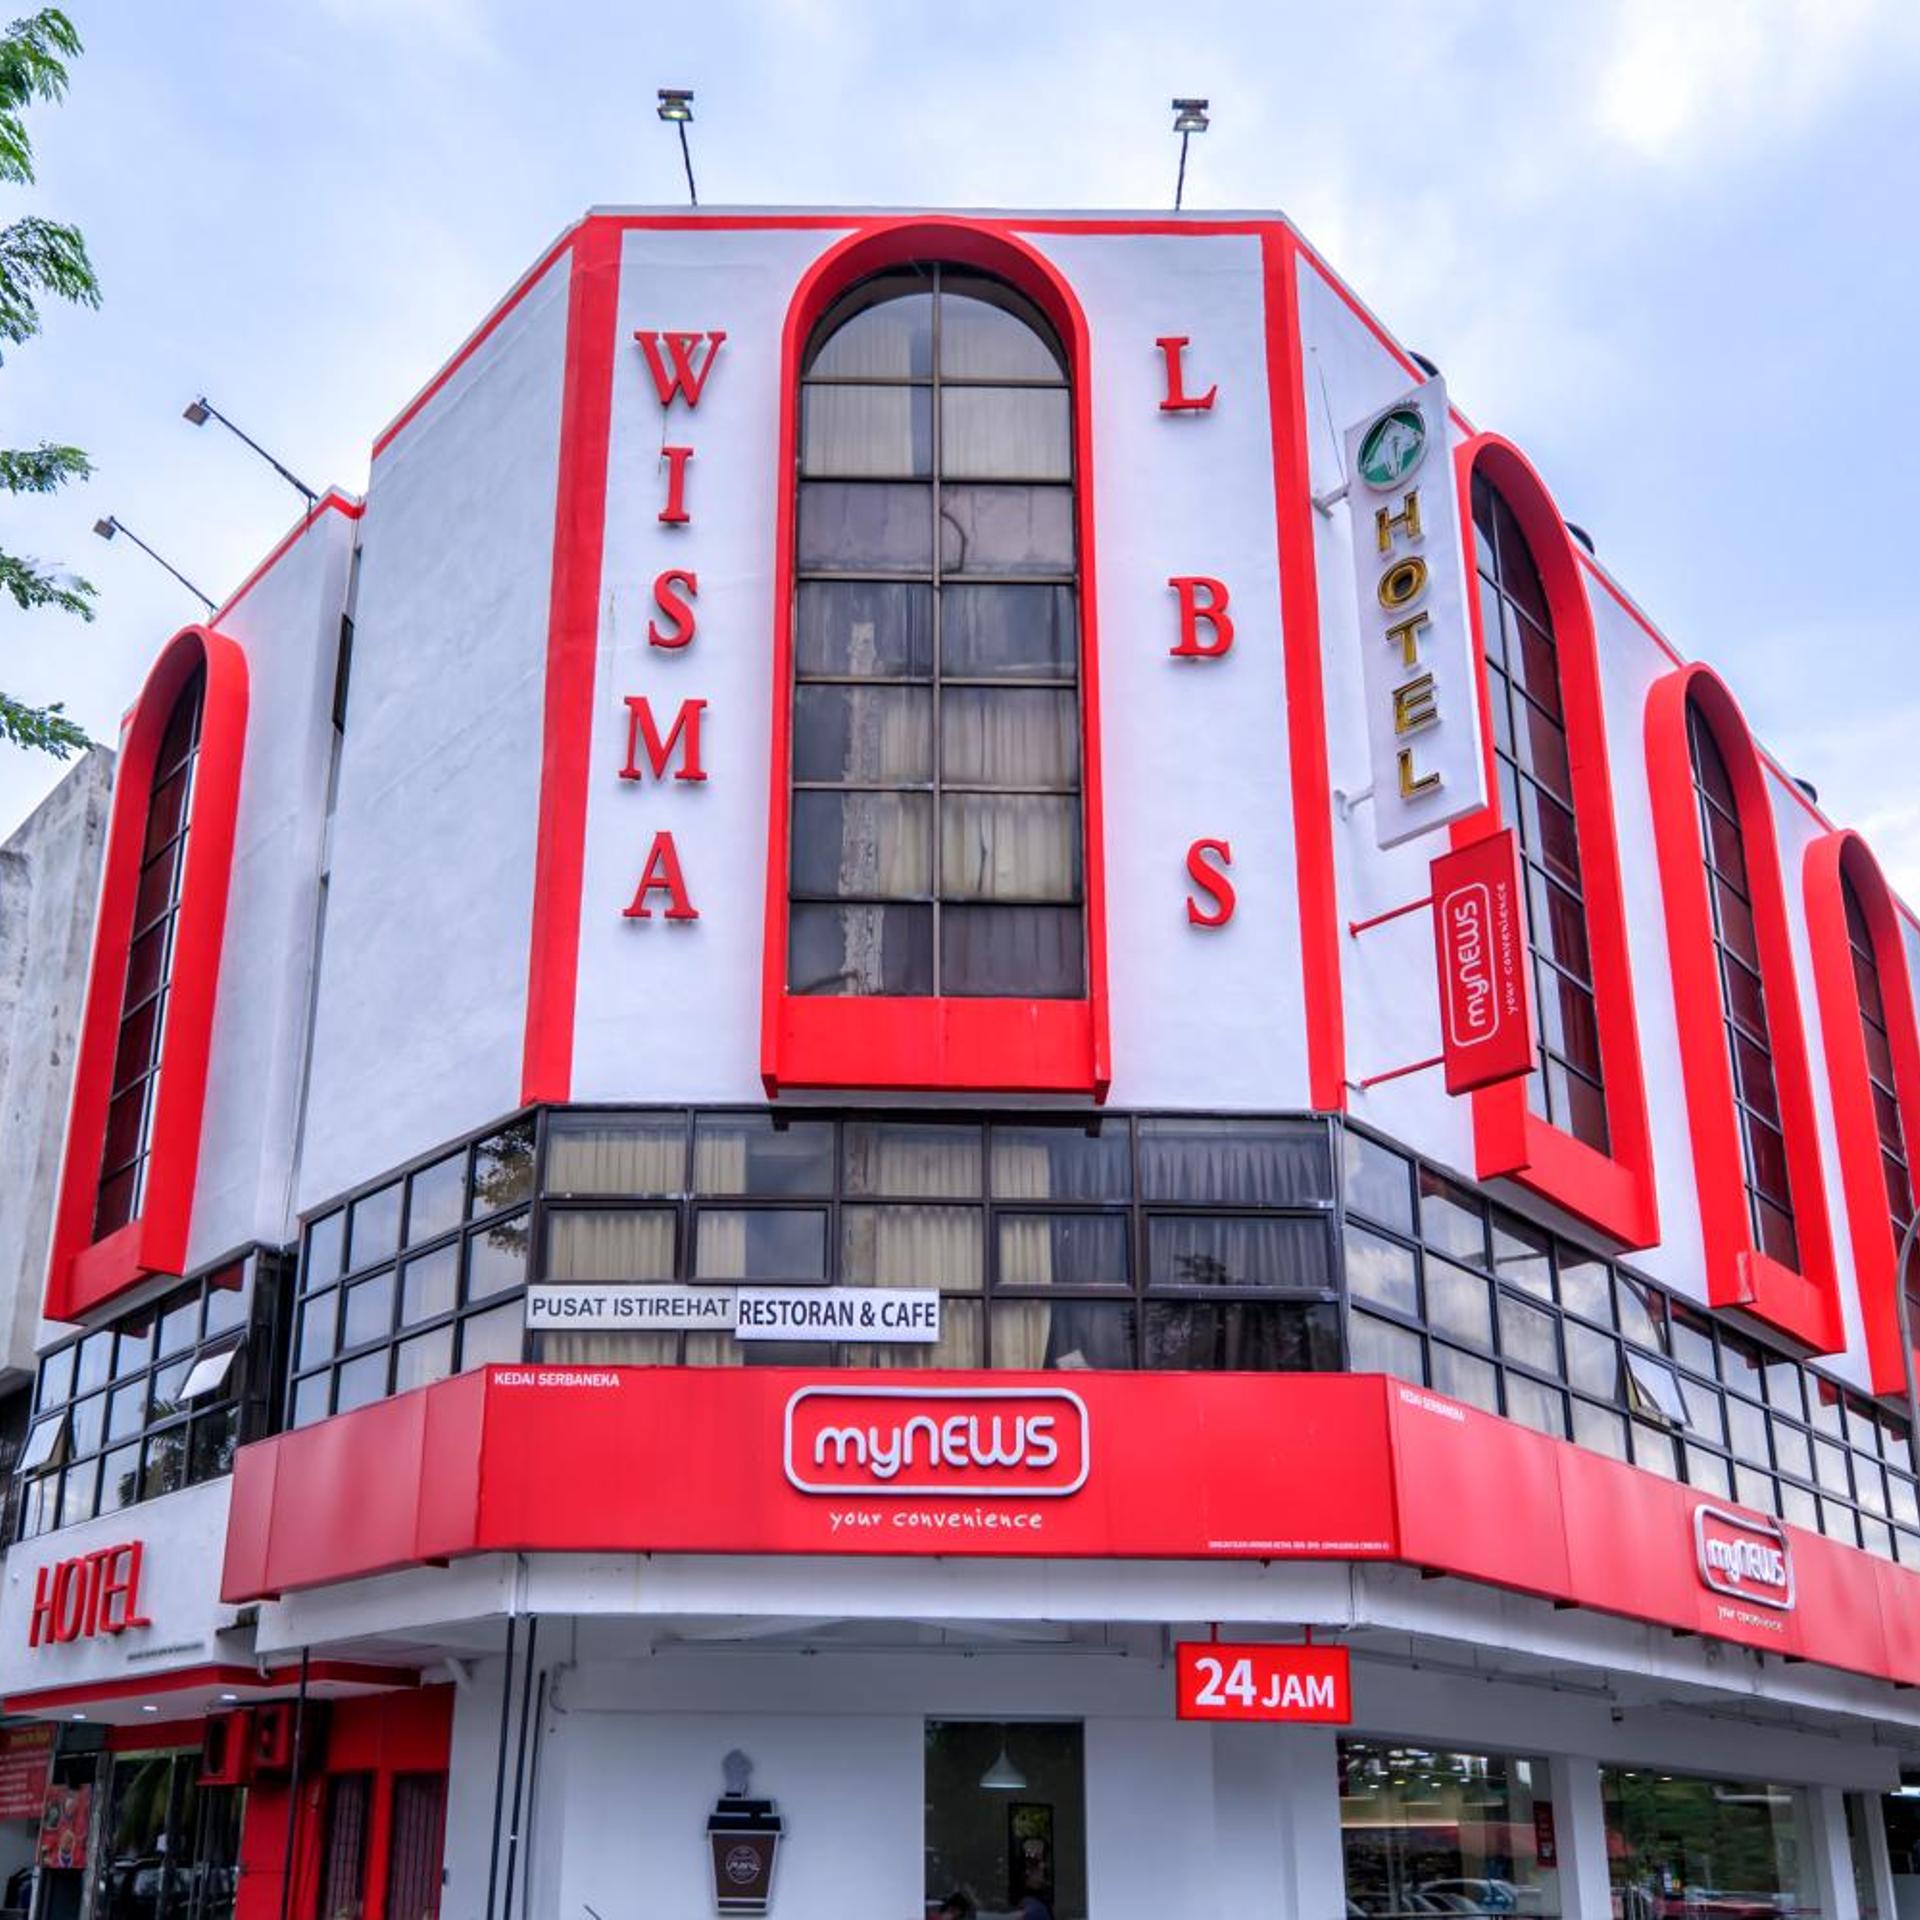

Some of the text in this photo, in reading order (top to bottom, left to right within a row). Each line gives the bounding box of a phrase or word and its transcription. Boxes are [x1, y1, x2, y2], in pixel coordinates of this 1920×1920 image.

[619, 331, 727, 920] WISMA
[1375, 488, 1441, 800] HOTEL
[1505, 981, 1518, 1015] your
[532, 1298, 731, 1317] PUSAT ISTIREHAT
[738, 1300, 936, 1328] RESTORAN & CAFE
[494, 1371, 620, 1387] KEDAI SERBANEKA
[830, 1508, 1043, 1531] your convenience
[29, 1540, 152, 1648] HOTEL
[1194, 1657, 1335, 1708] 24 JAM
